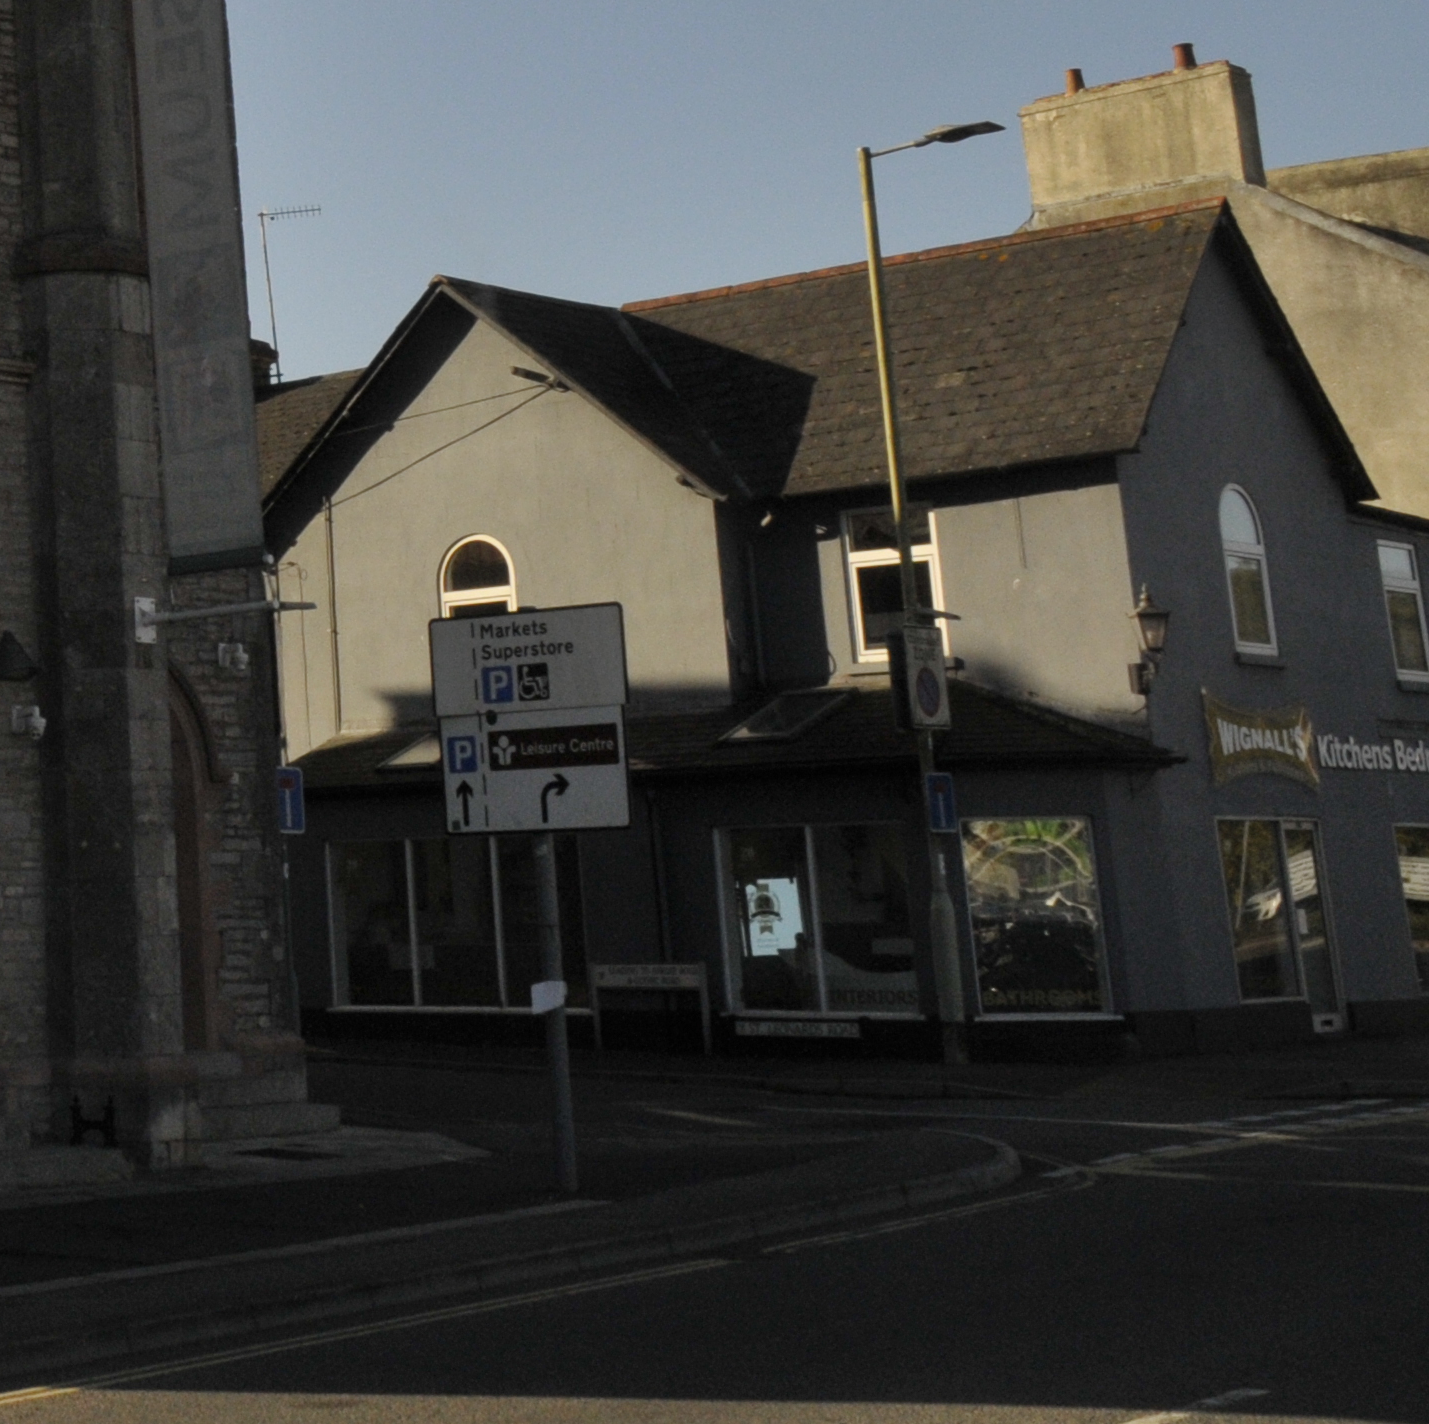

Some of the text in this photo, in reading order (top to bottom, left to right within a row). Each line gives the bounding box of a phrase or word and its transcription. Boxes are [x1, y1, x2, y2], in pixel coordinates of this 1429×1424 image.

[480, 620, 548, 640] Markets
[481, 640, 574, 662] Superstore
[520, 737, 615, 756] Leisure Centre
[1216, 716, 1308, 762] WIGNALL'S
[1317, 733, 1393, 770] Kitchens
[982, 989, 1102, 1007] BATHROOMS
